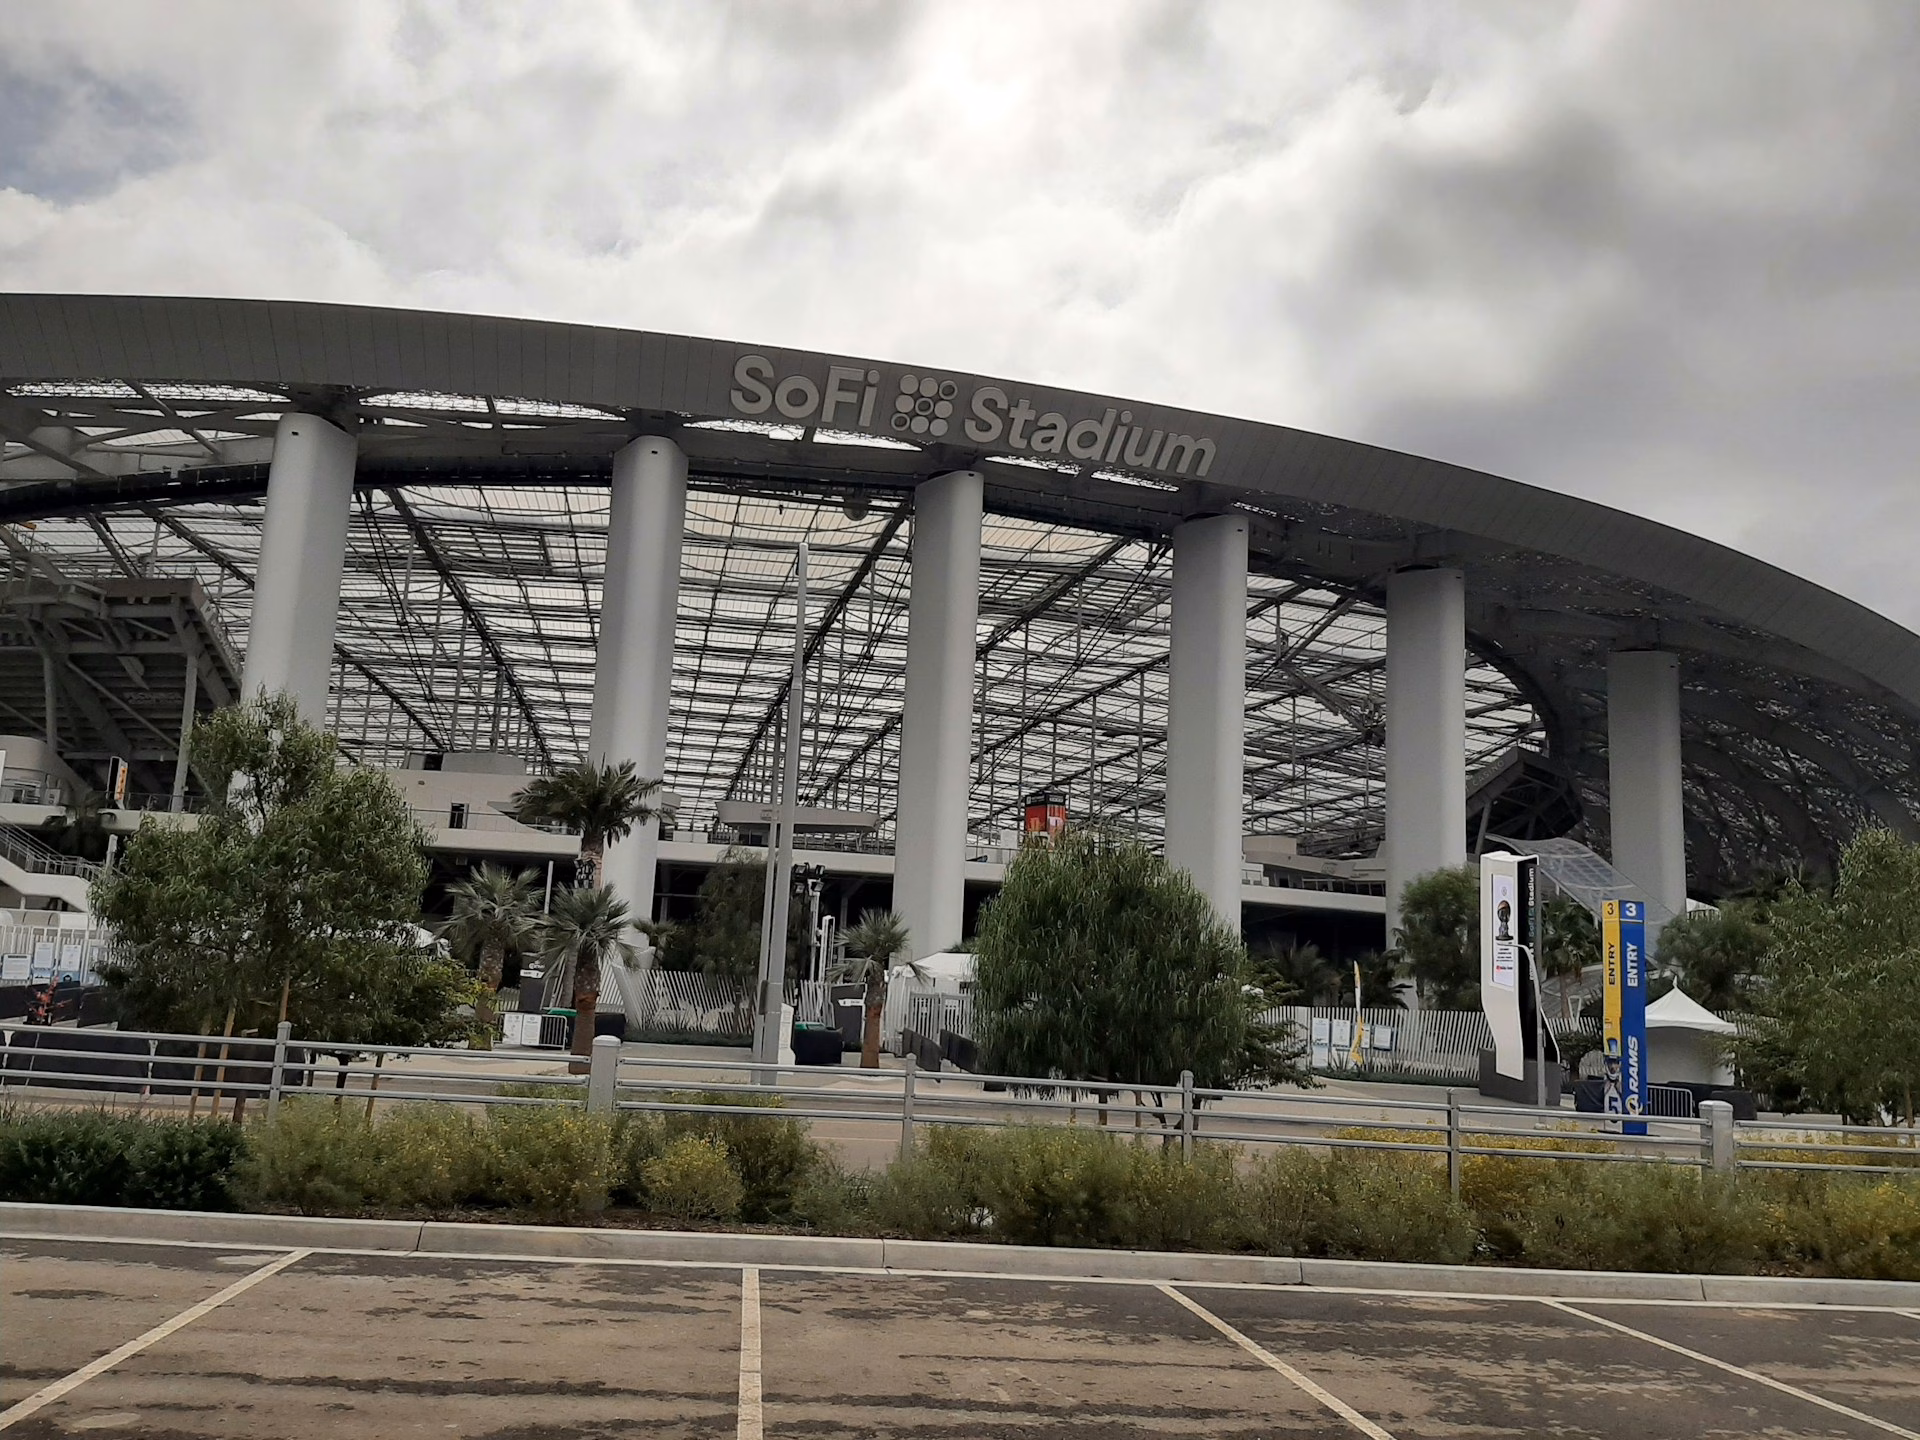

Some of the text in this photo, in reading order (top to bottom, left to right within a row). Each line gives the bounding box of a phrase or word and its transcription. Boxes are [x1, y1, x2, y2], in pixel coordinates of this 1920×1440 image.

[730, 354, 1217, 477] SoFi Stadium
[1528, 868, 1536, 907] Stadium
[1607, 903, 1614, 916] 3
[1625, 903, 1637, 917] 3
[1608, 942, 1616, 986] ENTRY
[1627, 942, 1638, 987] ENTRY
[1627, 1036, 1639, 1095] RAMS
